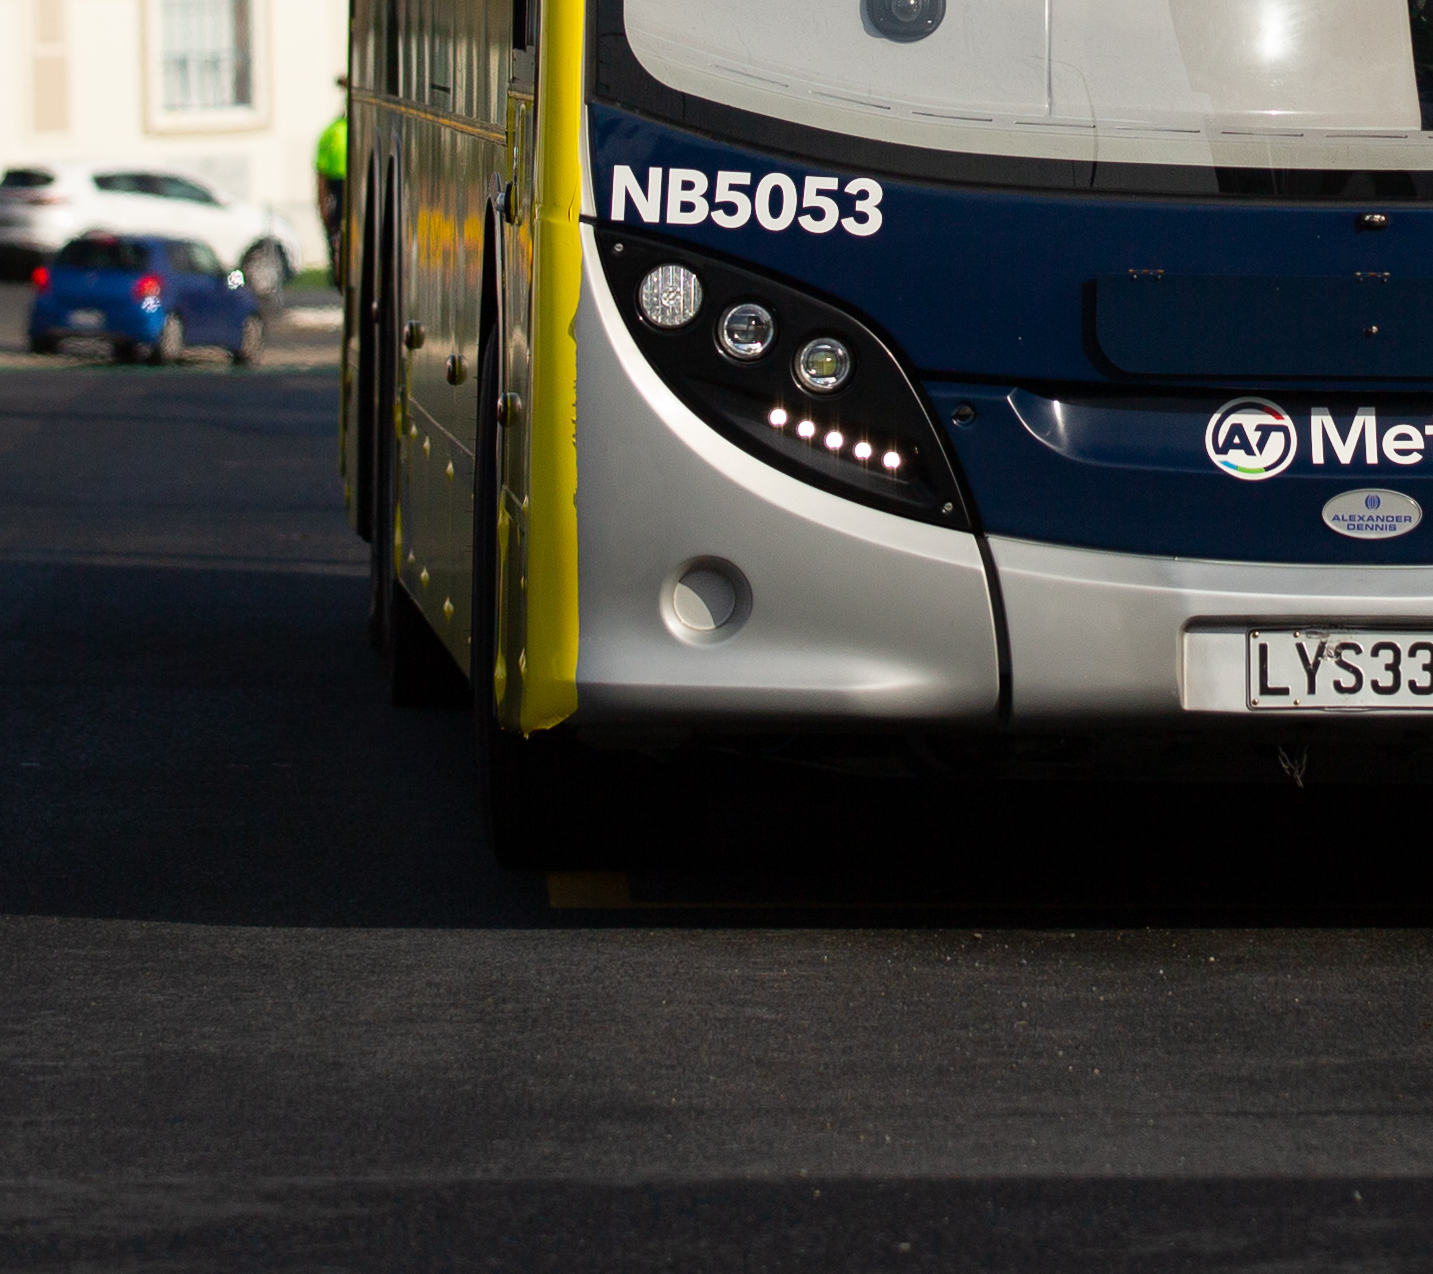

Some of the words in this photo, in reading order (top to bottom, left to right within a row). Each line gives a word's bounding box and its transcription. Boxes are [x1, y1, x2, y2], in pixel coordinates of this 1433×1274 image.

[610, 164, 884, 237] NB5053
[1331, 514, 1412, 523] ALEXANDER
[1347, 523, 1397, 531] DENNIS
